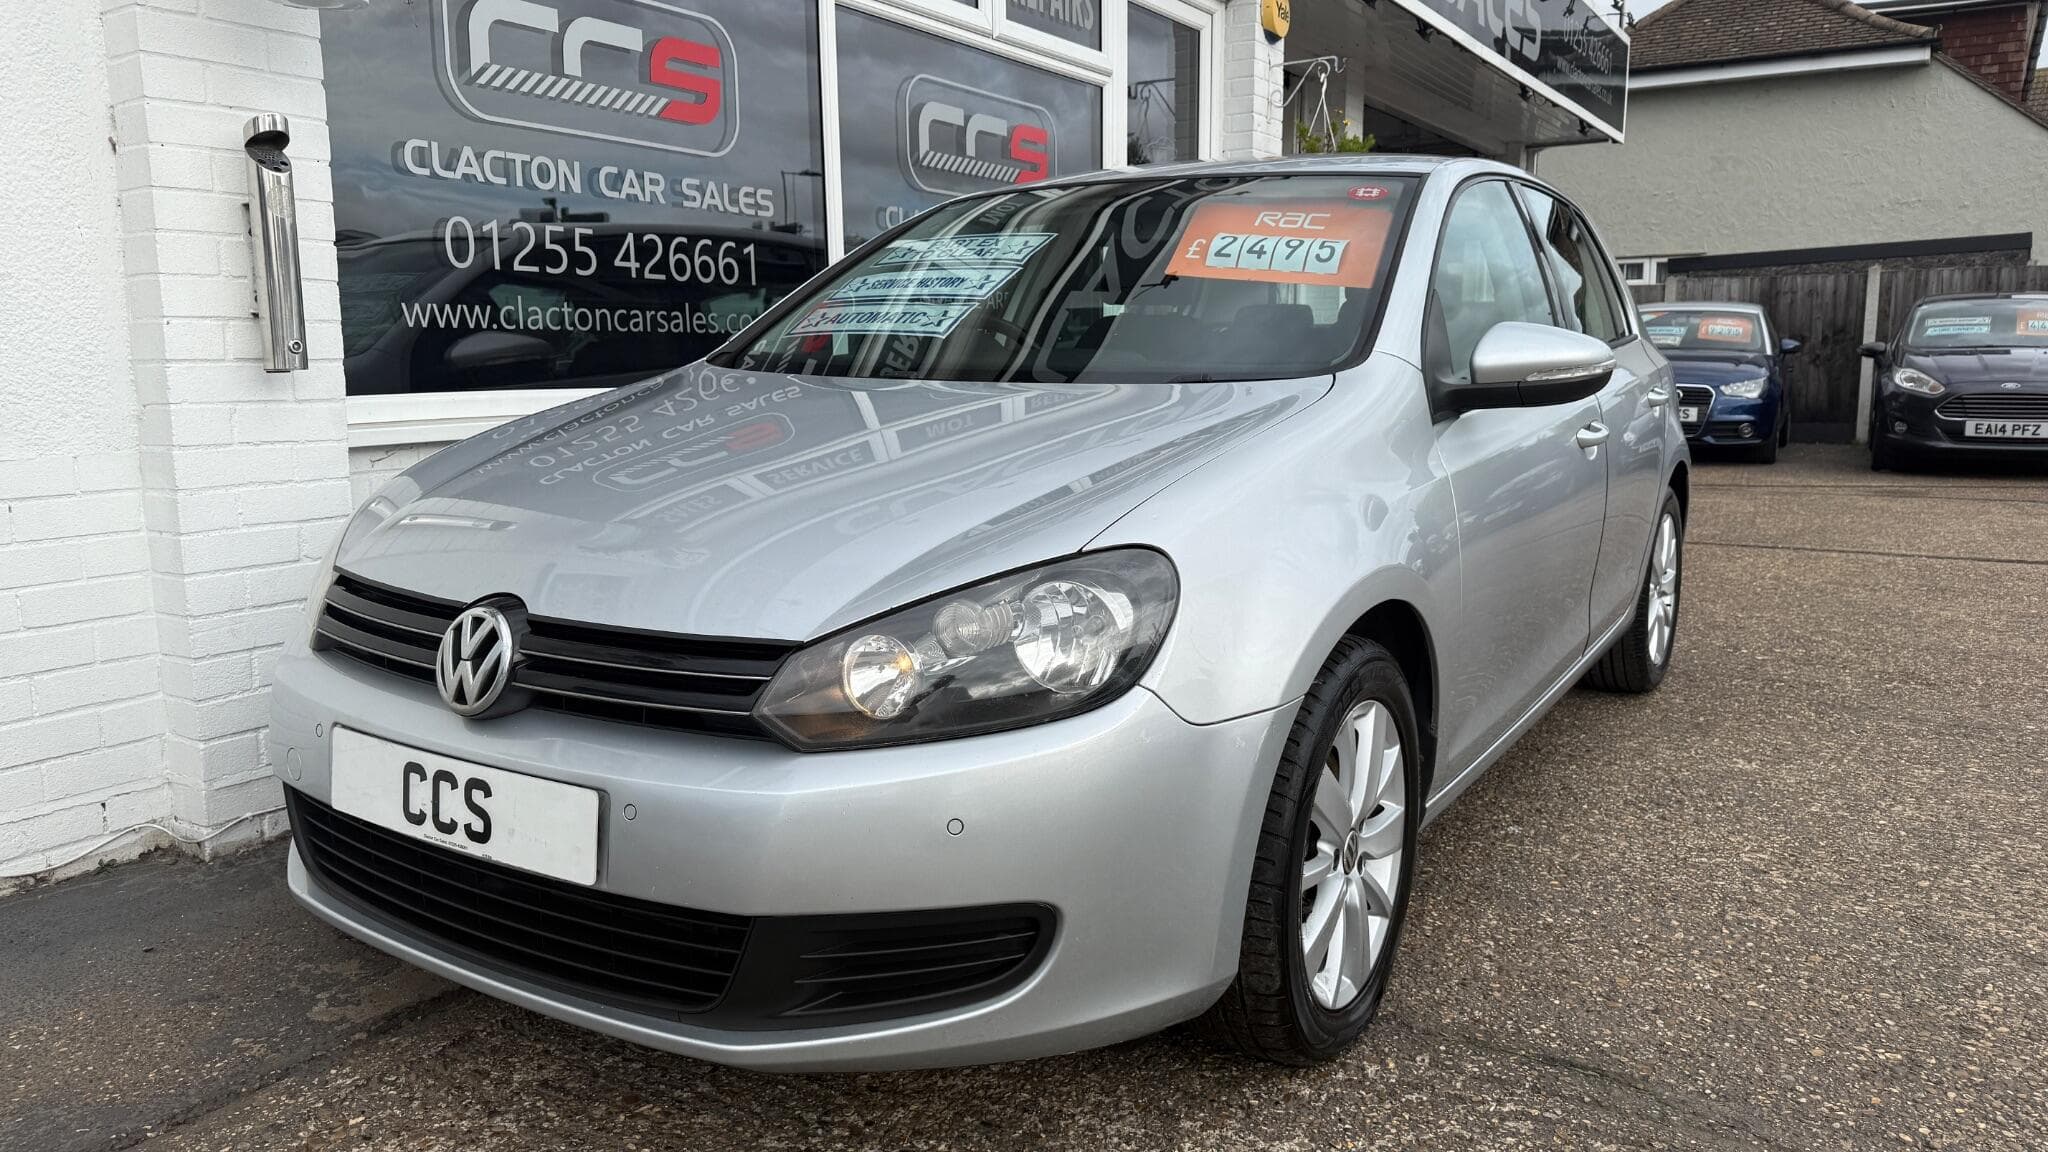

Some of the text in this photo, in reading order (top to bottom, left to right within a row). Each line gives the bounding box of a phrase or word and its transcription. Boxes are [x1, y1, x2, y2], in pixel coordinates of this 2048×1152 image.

[403, 138, 775, 218] CLACTON CAR SALES
[444, 215, 758, 287] 01255 426661
[937, 248, 1000, 258] CLEAR
[866, 275, 969, 290] SERVICE HISTORY
[827, 311, 928, 325] AUTOMATIC
[1975, 423, 2042, 436] EA14 PFZ
[402, 761, 493, 845] CCS
